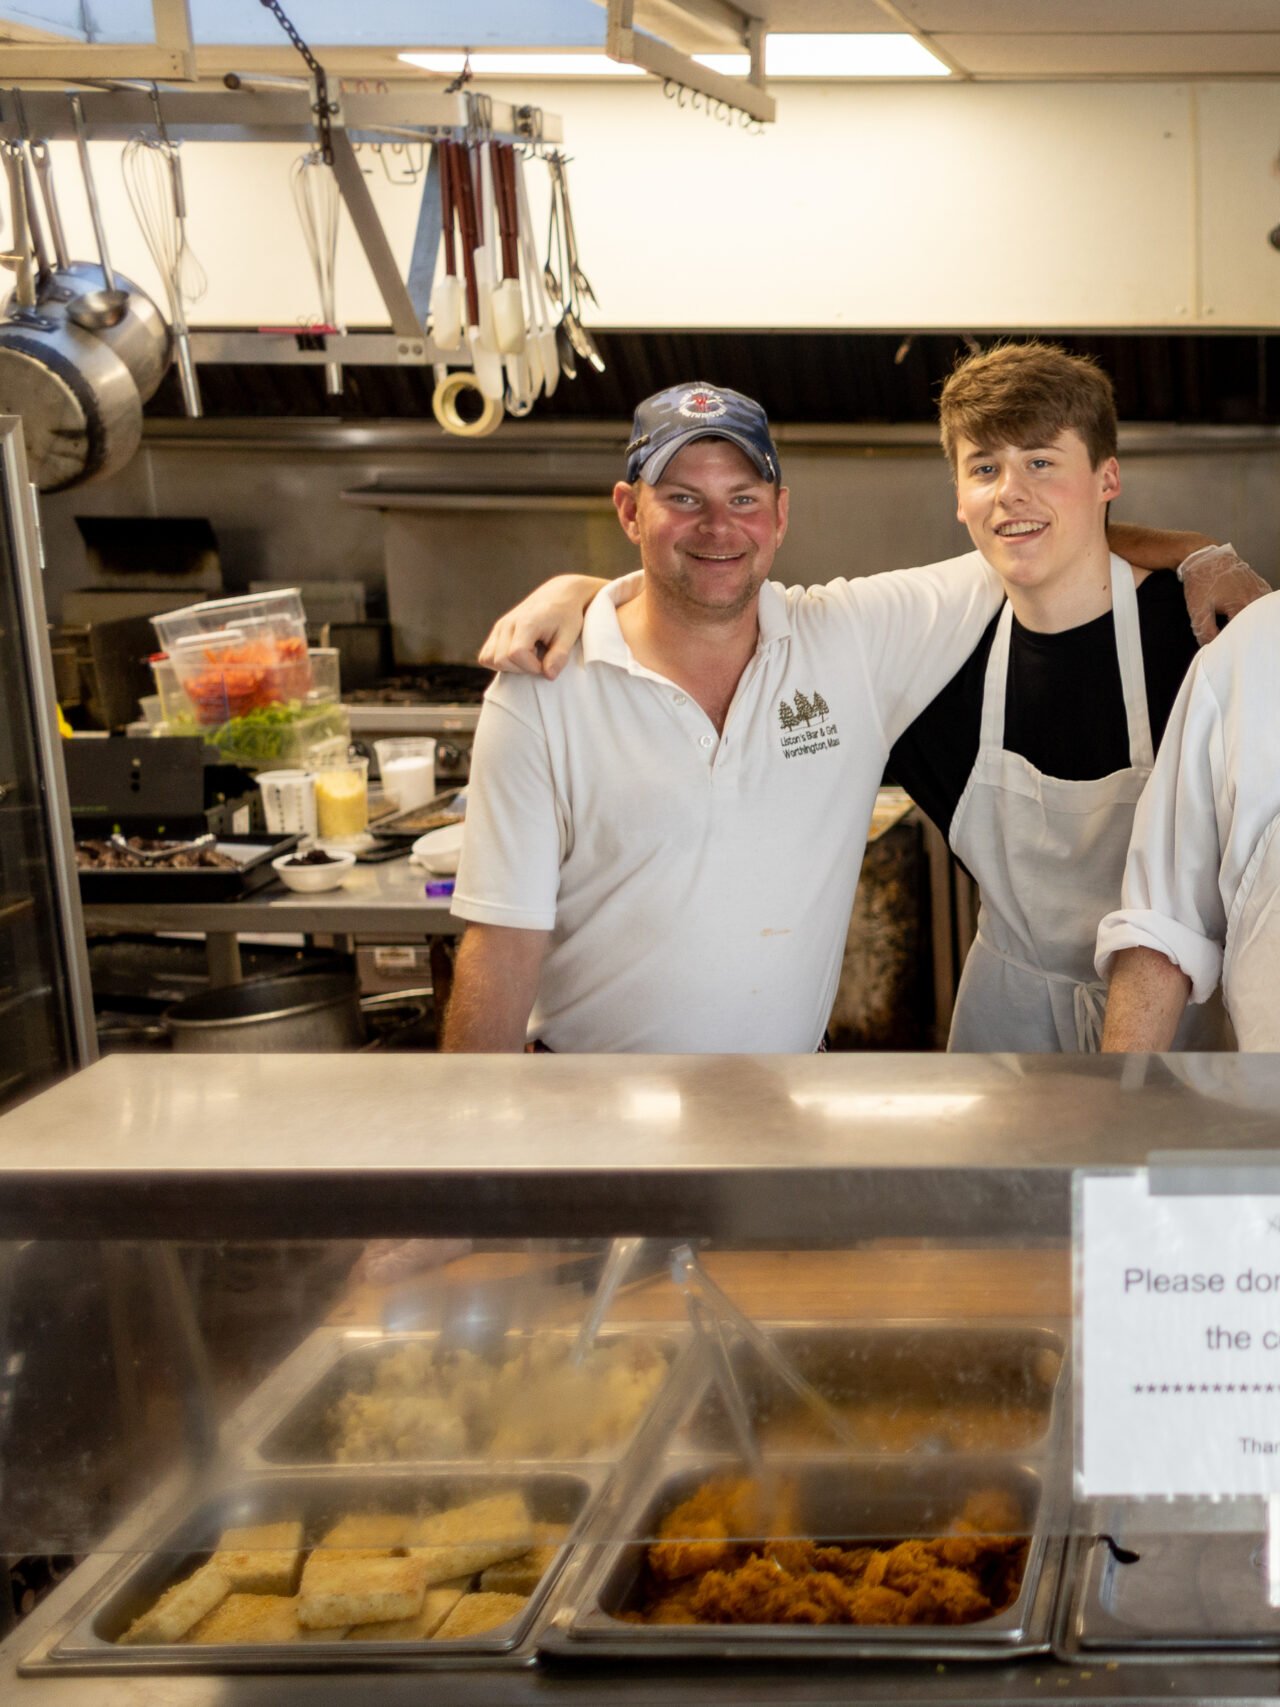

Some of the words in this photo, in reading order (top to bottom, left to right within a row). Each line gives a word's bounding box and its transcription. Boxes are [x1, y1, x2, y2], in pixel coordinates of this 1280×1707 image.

[806, 730, 819, 741] Bar
[1123, 1267, 1226, 1294] Please
[1205, 1325, 1252, 1351] the
